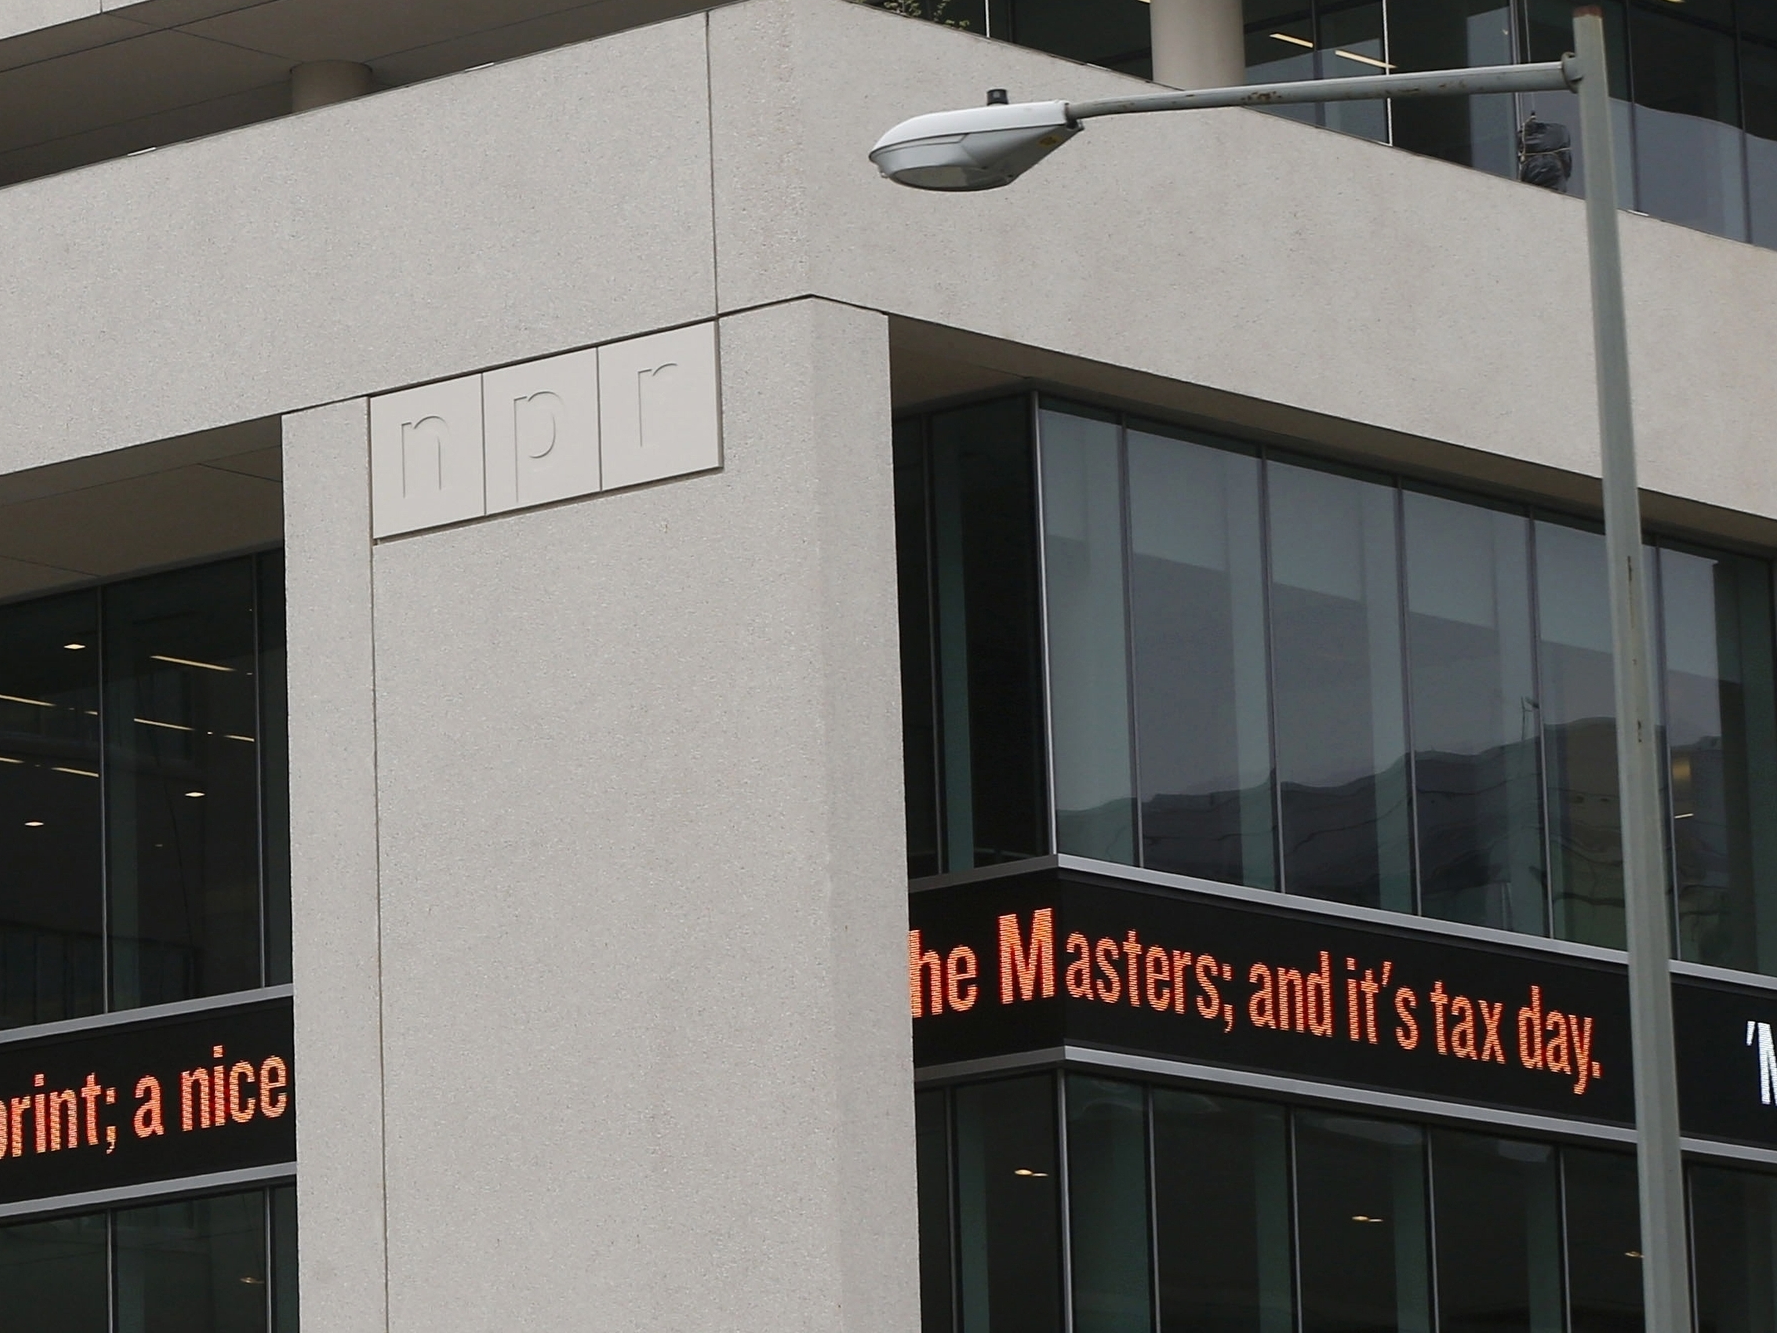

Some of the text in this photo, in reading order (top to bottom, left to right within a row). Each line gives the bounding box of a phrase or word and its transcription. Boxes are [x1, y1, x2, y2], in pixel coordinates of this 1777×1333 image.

[400, 362, 678, 503] npr
[998, 908, 1234, 1033] Masters;
[1248, 951, 1333, 1037] and
[1346, 957, 1419, 1050] it's
[1430, 981, 1506, 1063] tax
[1517, 985, 1602, 1095] day.
[133, 1075, 165, 1139] a
[180, 1045, 288, 1132] nice
